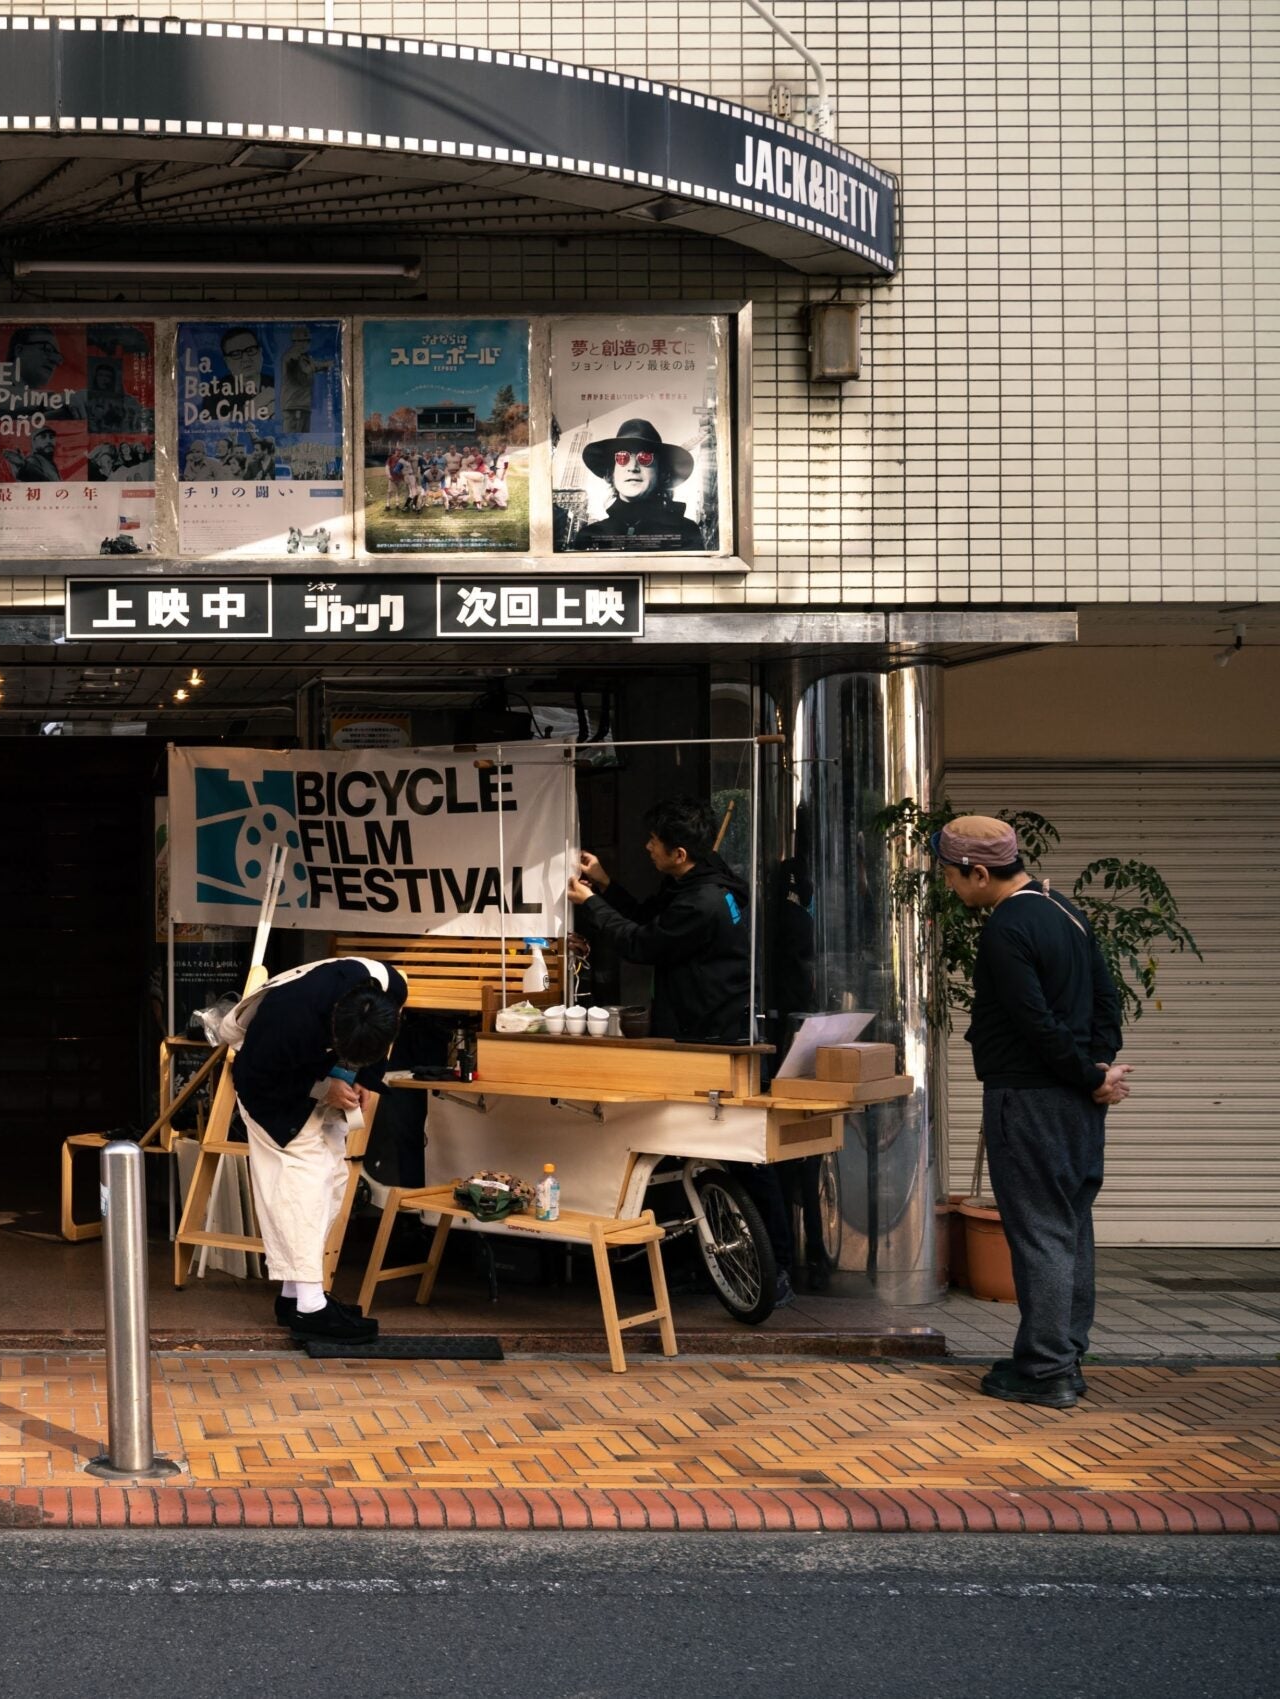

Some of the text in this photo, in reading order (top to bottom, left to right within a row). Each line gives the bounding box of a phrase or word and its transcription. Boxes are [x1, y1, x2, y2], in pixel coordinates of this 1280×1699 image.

[735, 135, 879, 238] JACK&BETTY
[422, 334, 468, 345] さよならは
[571, 339, 696, 357] 夢と創造の果てに
[184, 347, 212, 373] La
[571, 359, 696, 371] ジョン・レノン最後の詩
[184, 373, 257, 399] Batalla
[0, 411, 46, 437] año
[184, 400, 270, 425] De Chile
[184, 486, 294, 499] チリの闘い
[306, 582, 336, 592] シネマ
[91, 587, 247, 628] 上映中
[304, 594, 405, 632] ジャック
[456, 587, 625, 627] 次回上映
[295, 764, 518, 817] BICYCLE
[298, 819, 414, 866] FILM
[304, 866, 542, 914] FESTIVAL
